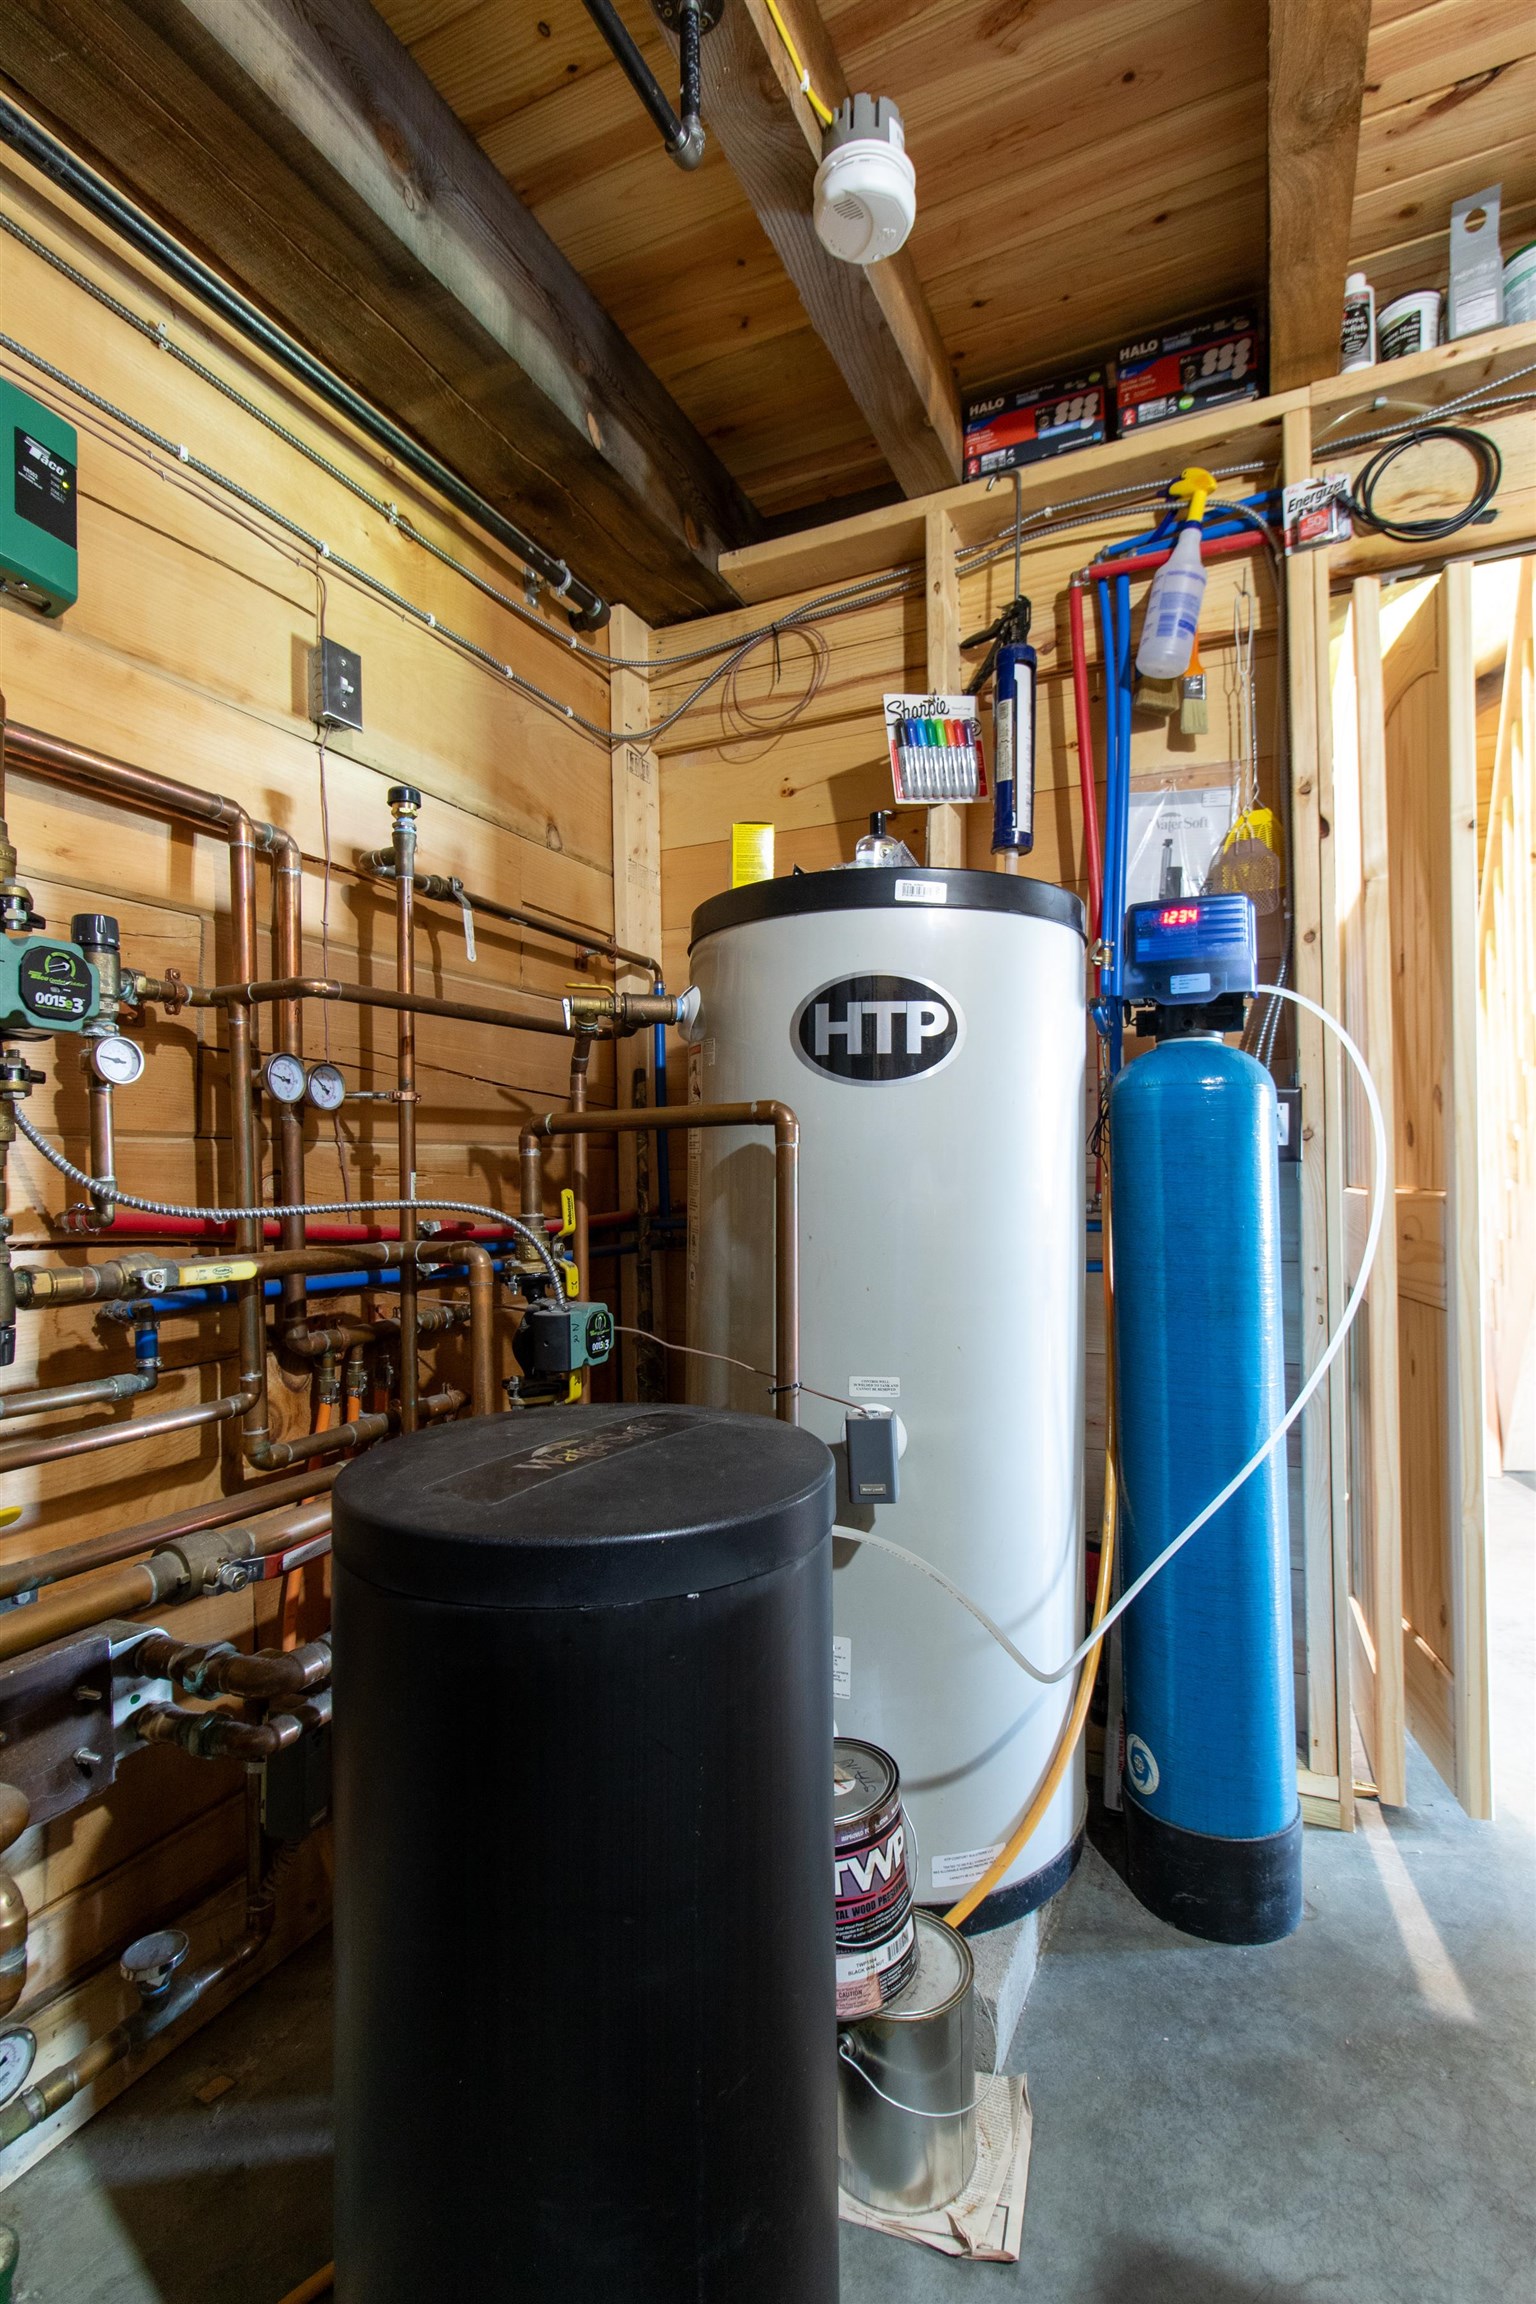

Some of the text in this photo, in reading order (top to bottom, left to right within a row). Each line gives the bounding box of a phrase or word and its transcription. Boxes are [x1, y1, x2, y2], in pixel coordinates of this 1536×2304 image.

[1120, 340, 1159, 361] HALO
[969, 397, 1005, 417] HALO
[24, 436, 65, 476] Taco
[1287, 479, 1348, 514] Energizer
[886, 697, 950, 722] Sharpie
[1184, 816, 1209, 829] Soft
[1162, 908, 1198, 925] 1234
[814, 1001, 949, 1055] HTP
[835, 1825, 904, 1896] TWP
[835, 1910, 849, 1921] TAL
[851, 1900, 876, 1917] WOOD
[838, 1990, 863, 1998] CAUTION
